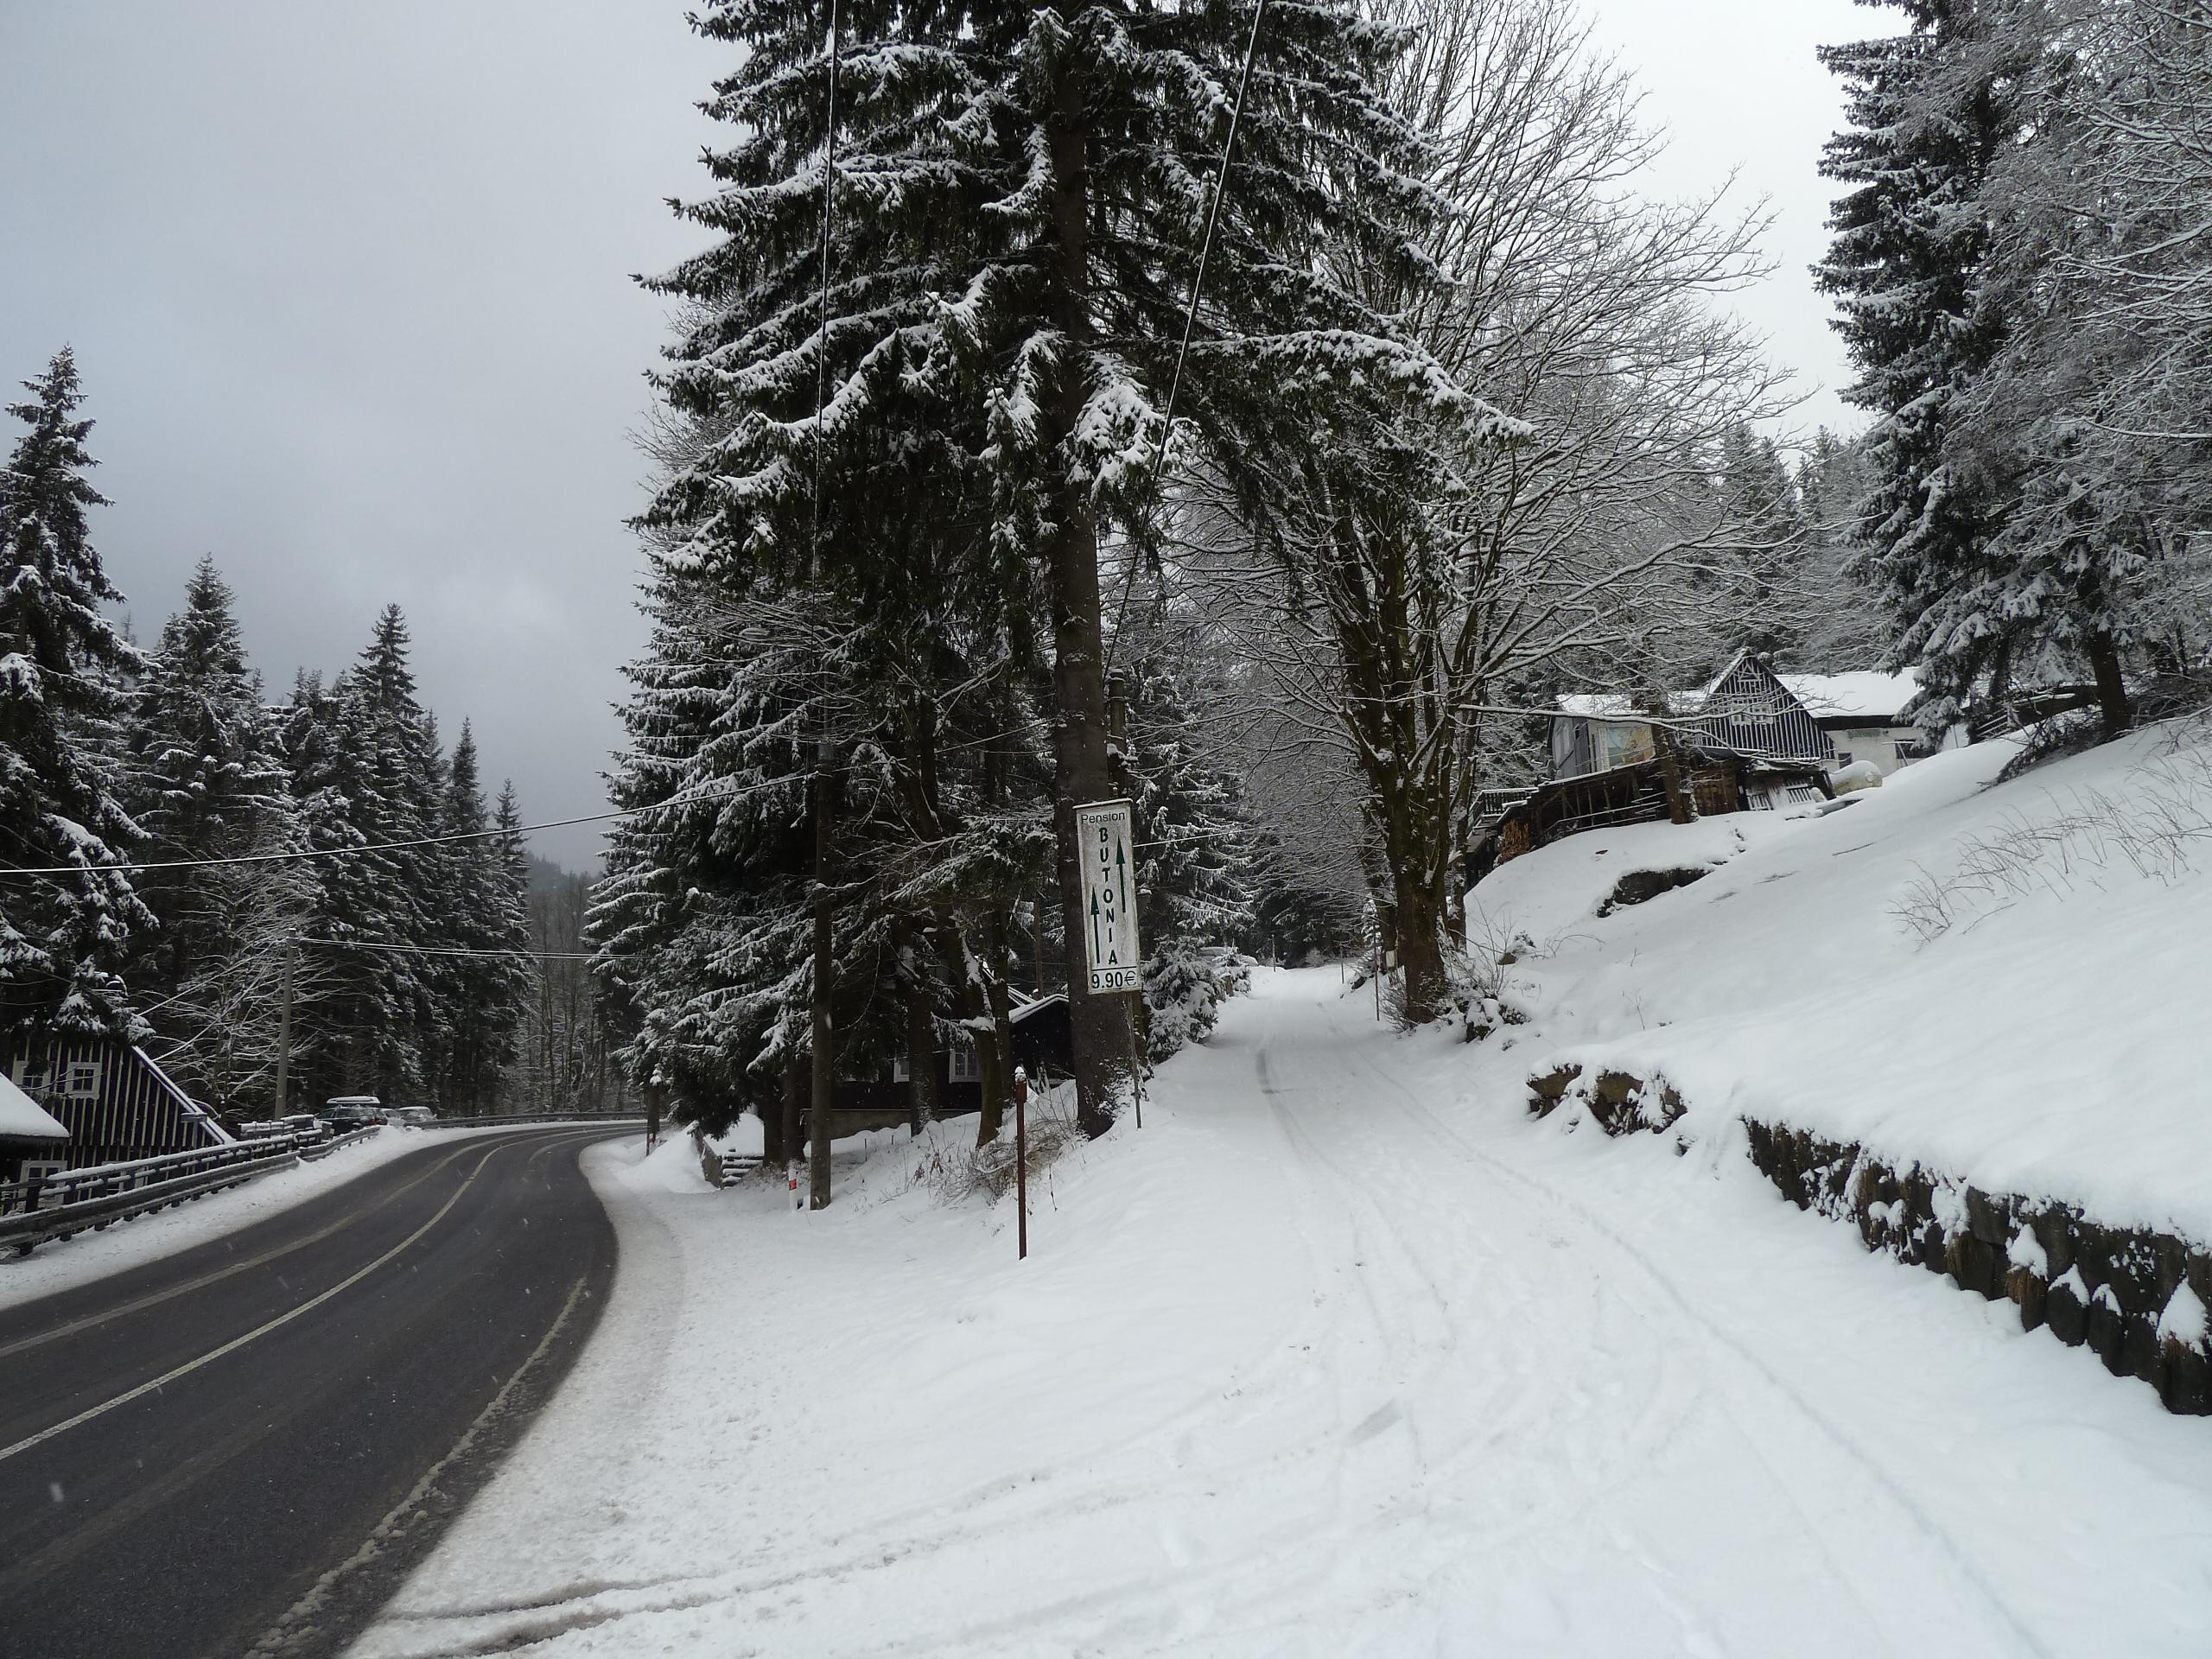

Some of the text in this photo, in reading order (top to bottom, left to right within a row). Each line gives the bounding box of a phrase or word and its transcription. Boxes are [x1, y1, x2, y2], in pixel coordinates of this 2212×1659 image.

[1081, 812, 1125, 824] Pension
[1098, 827, 1118, 965] BUTONIA
[1091, 970, 1137, 989] 9.90€
